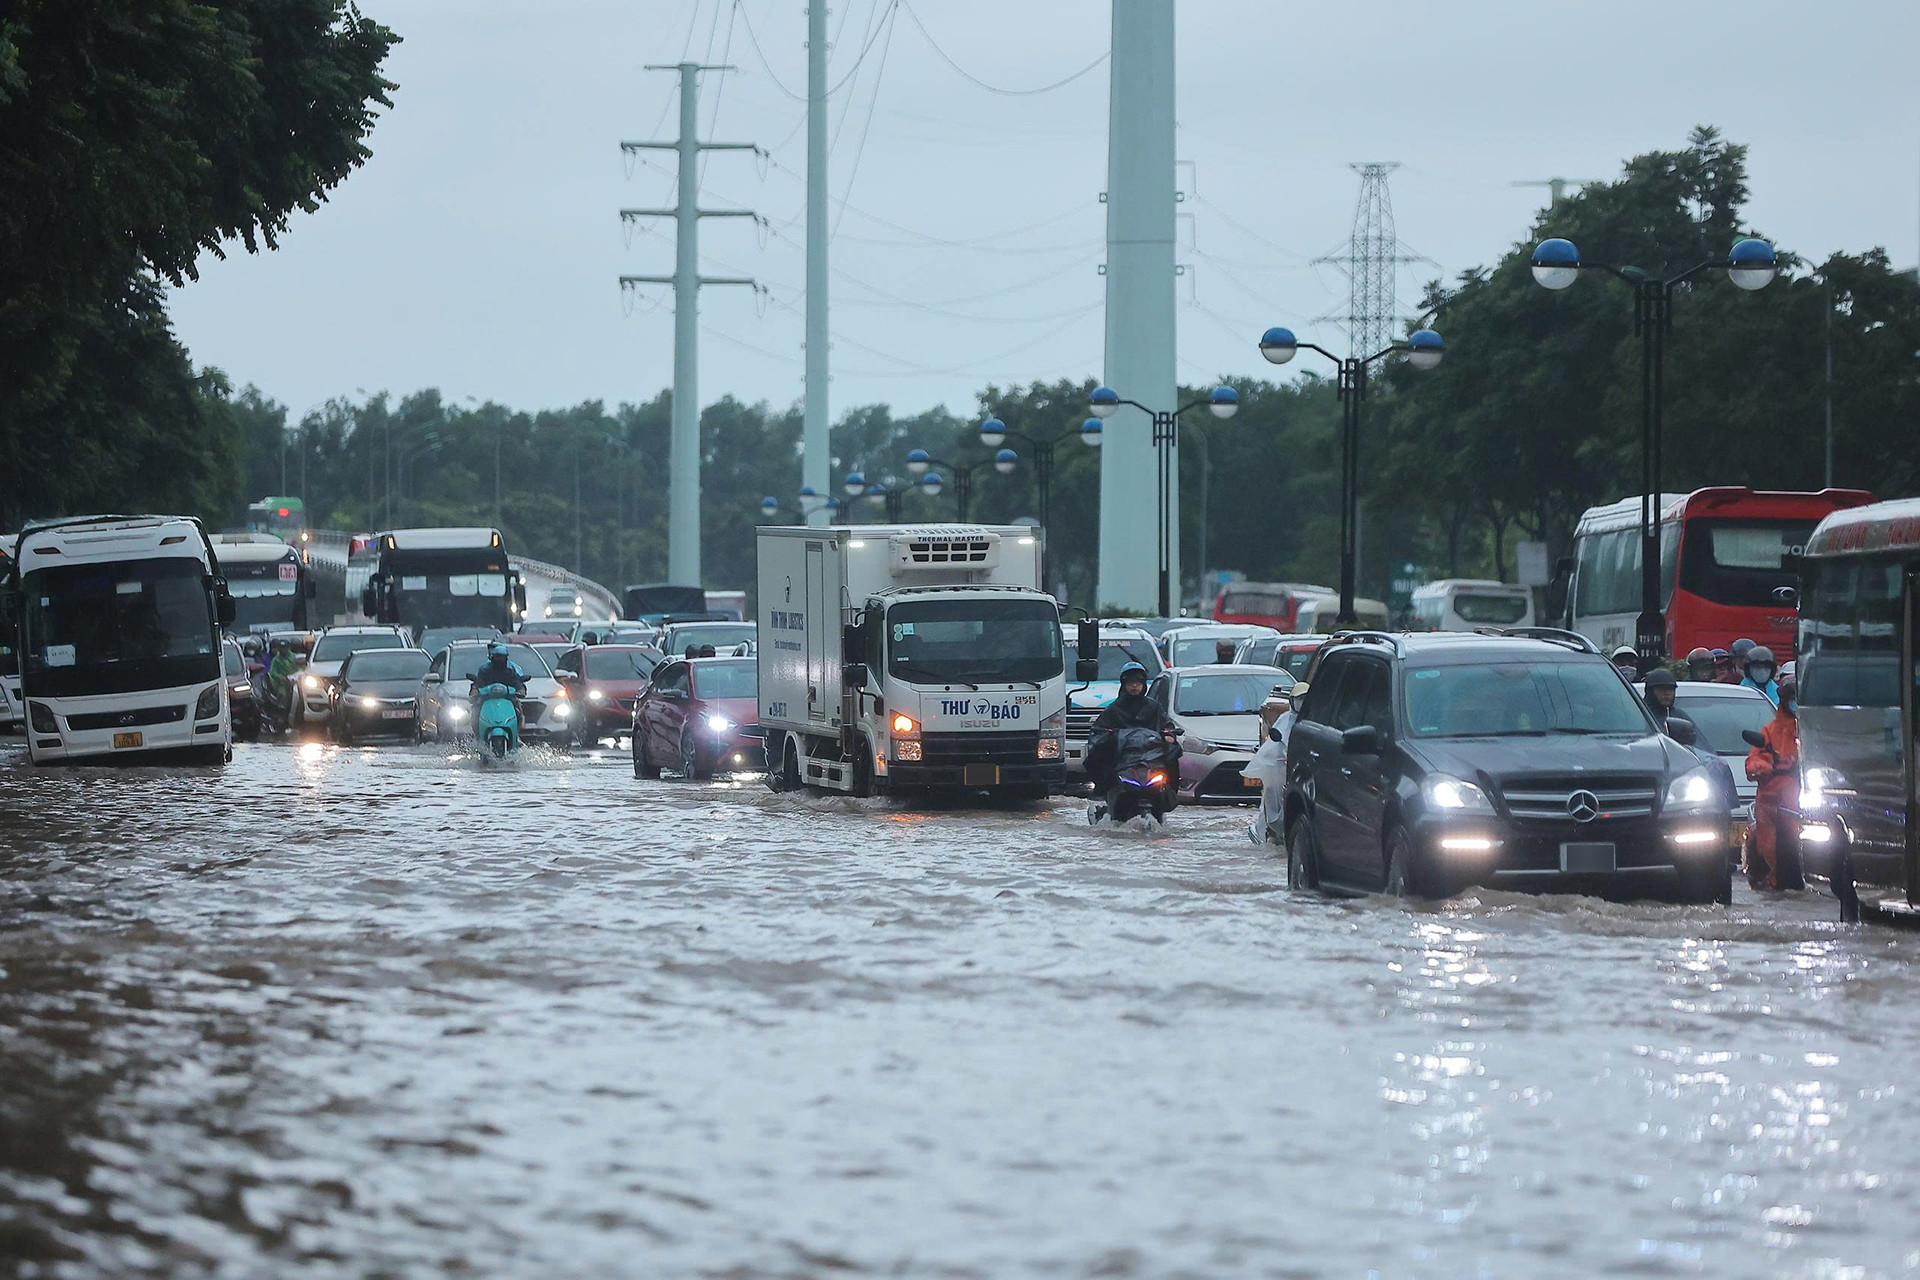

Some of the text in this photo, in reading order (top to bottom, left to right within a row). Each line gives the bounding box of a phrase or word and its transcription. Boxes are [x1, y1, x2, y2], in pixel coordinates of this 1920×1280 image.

[941, 699, 971, 715] THƯ
[991, 700, 1021, 719] BÁO
[960, 720, 1000, 728] ISUZU
